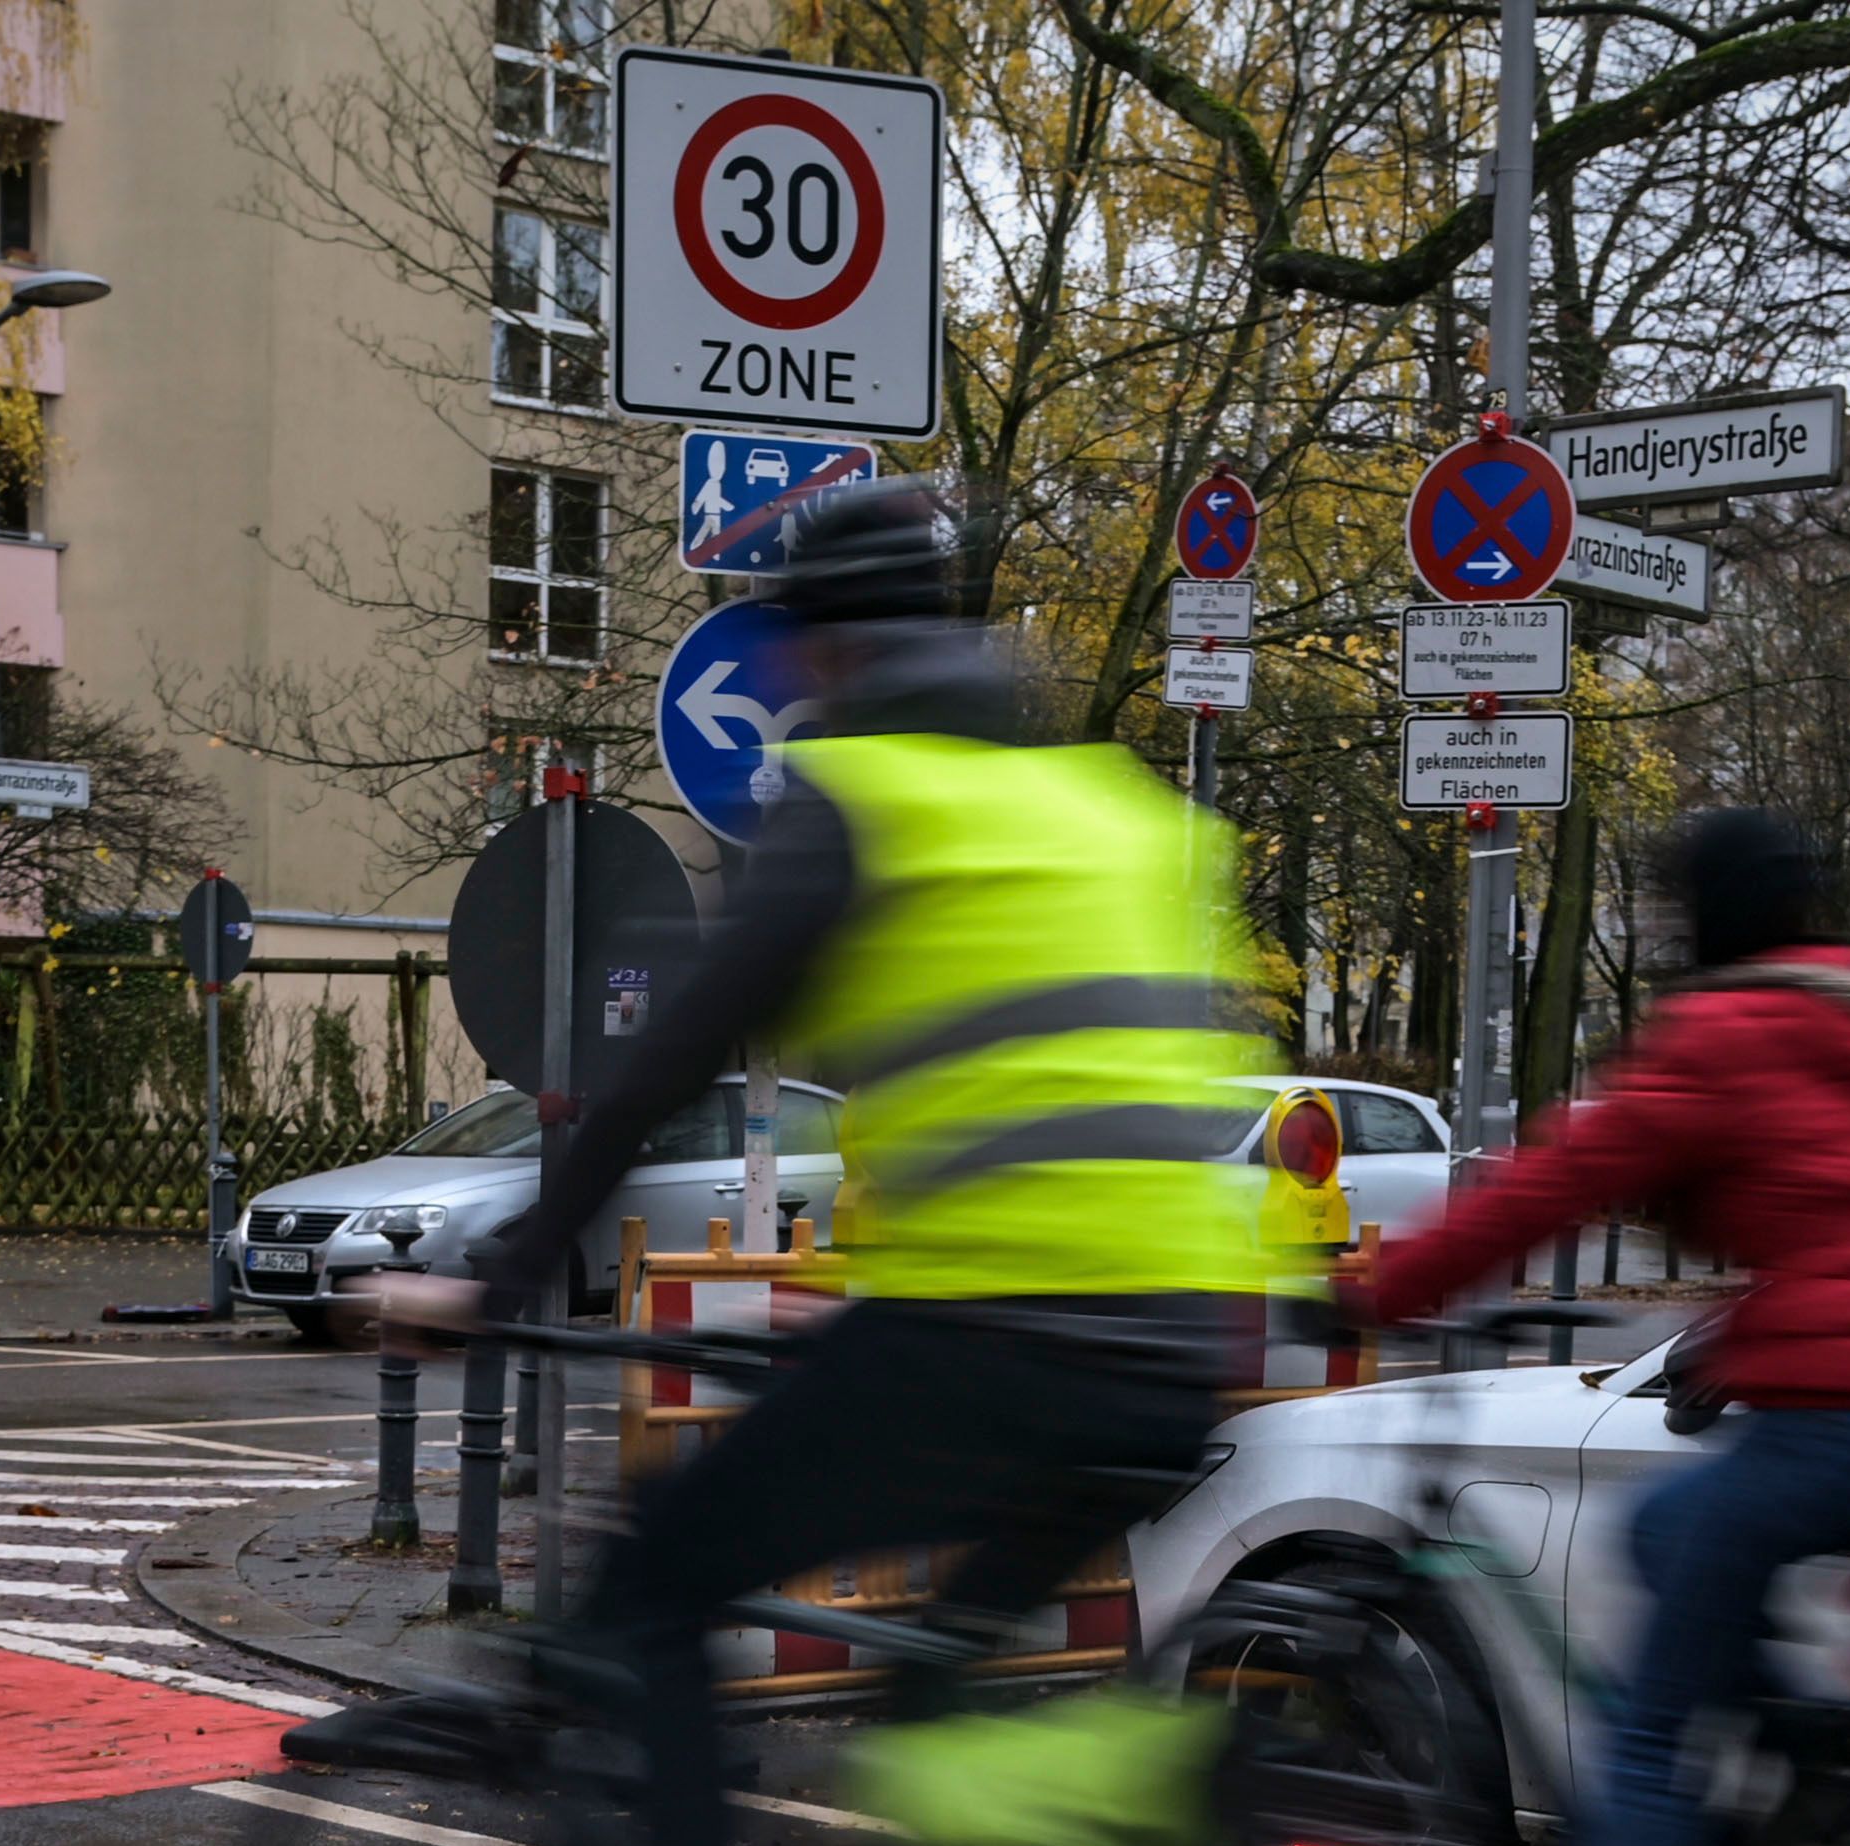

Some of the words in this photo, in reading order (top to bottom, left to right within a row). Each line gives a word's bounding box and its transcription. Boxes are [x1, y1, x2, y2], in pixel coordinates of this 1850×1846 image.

[720, 154, 841, 267] 30
[699, 338, 857, 406] ZONE
[1567, 412, 1809, 482] Handjerystraße
[1407, 612, 1425, 627] ab
[1431, 611, 1548, 628] 13.11.23-16.11.23
[1459, 631, 1478, 647] 07
[1482, 631, 1492, 647] h
[1455, 667, 1493, 681] Flächen
[1446, 727, 1493, 746] auch
[1500, 727, 1518, 746] in
[1416, 751, 1547, 774] gekennzeichneten
[1440, 779, 1519, 800] Flächen
